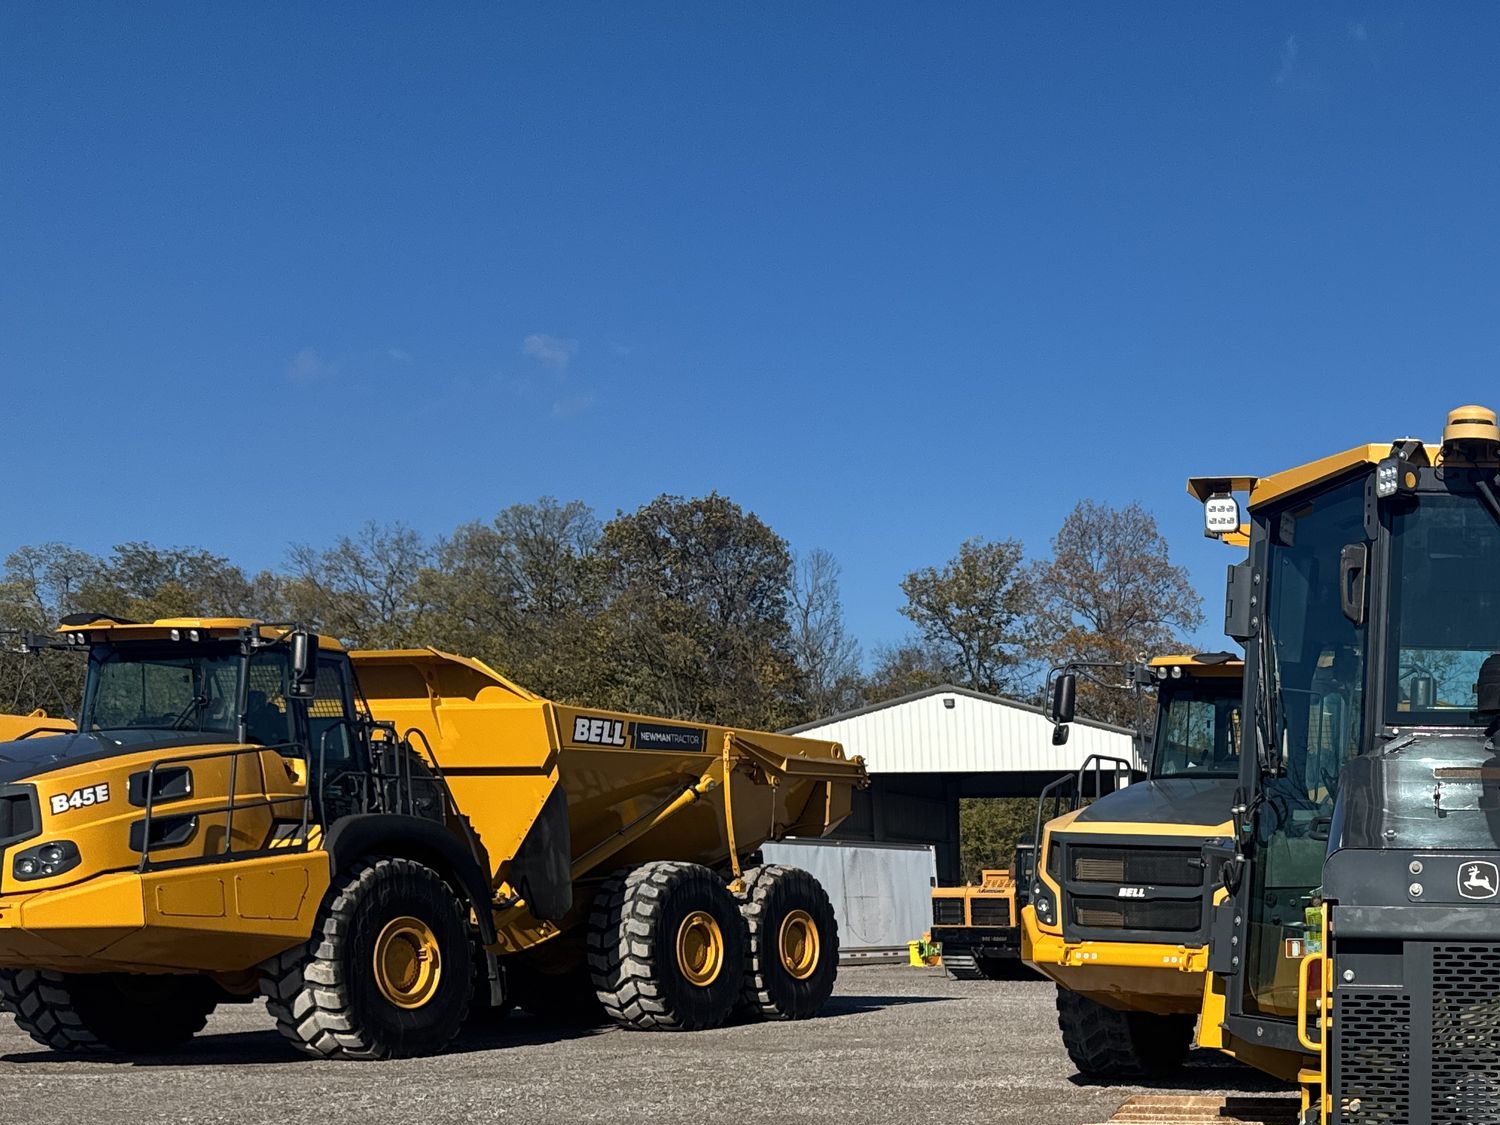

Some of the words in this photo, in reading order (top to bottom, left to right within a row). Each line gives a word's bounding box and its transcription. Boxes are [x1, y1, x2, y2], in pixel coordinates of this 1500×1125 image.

[573, 717, 625, 745] BELL
[640, 731, 700, 745] NEWMANTRACTOR
[50, 783, 110, 815] B45E
[1118, 887, 1145, 897] BELL
